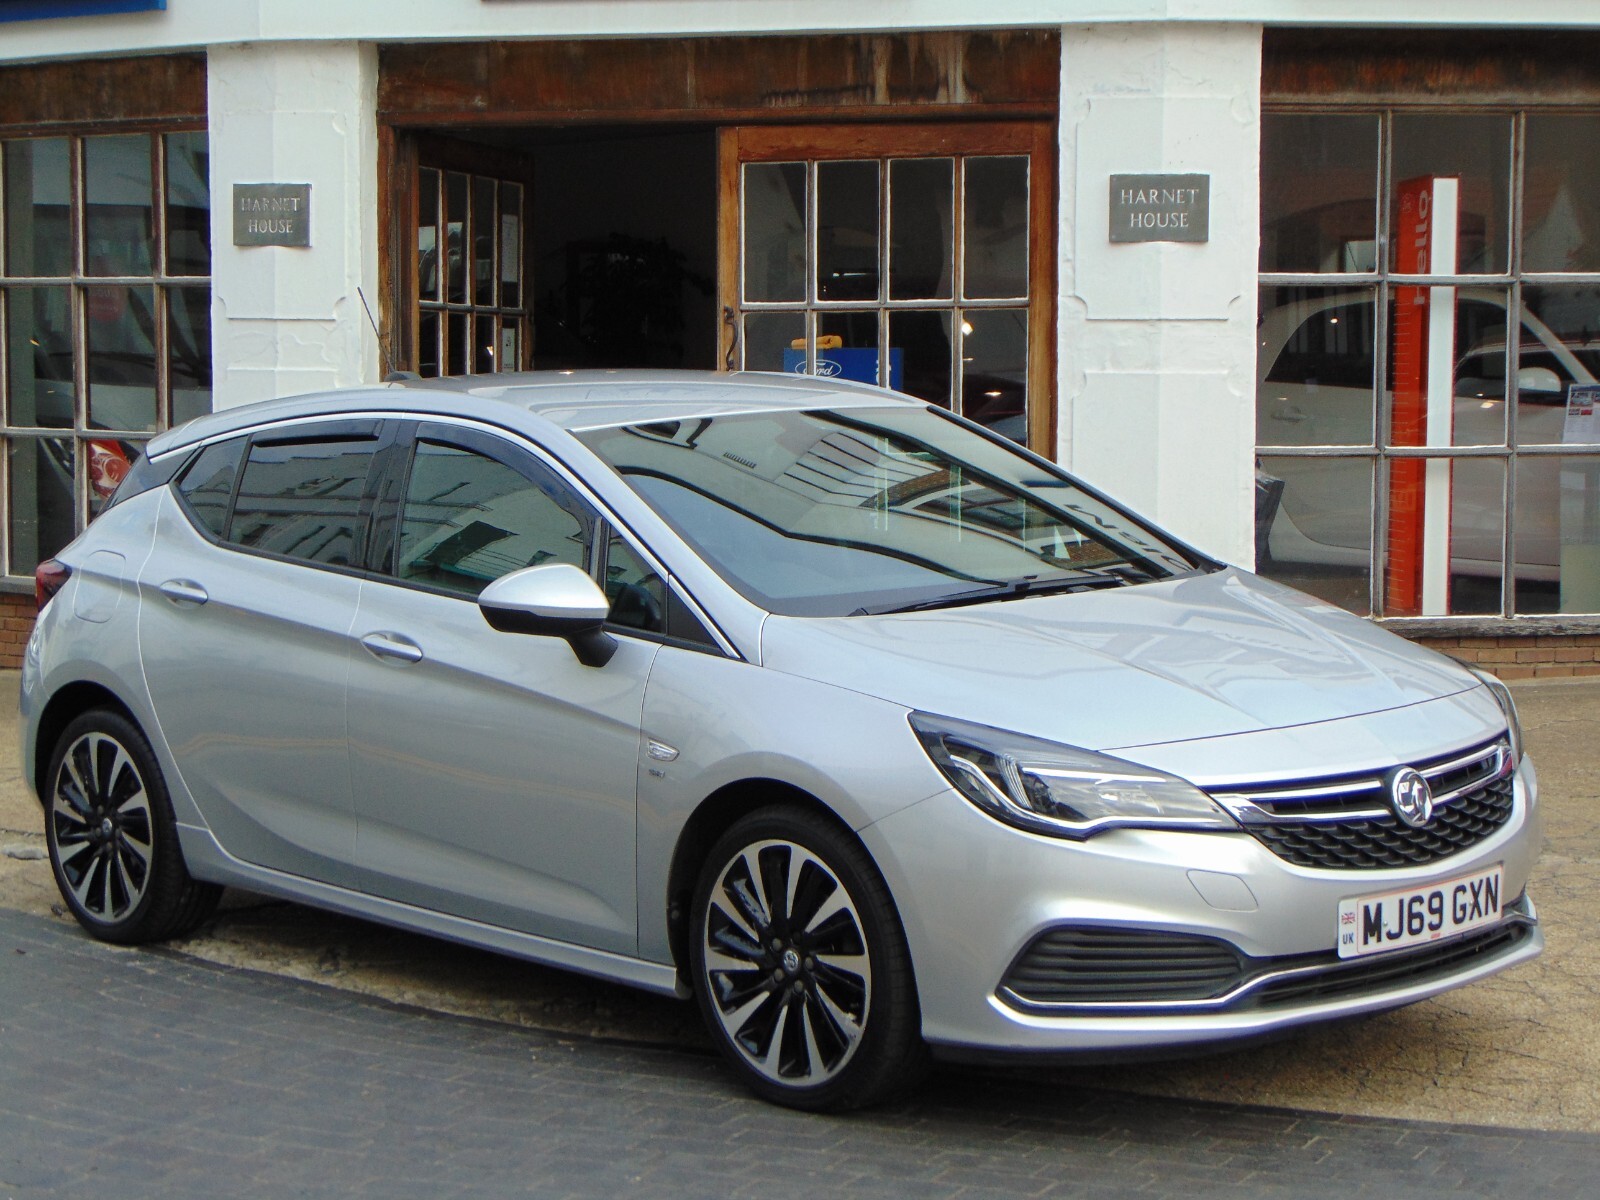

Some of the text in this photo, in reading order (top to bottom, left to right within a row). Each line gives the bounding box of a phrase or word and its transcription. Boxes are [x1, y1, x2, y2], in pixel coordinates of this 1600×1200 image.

[1121, 188, 1199, 204] HARNET
[241, 197, 300, 212] HARNET
[248, 219, 293, 233] HOUSE
[1130, 212, 1189, 228] HOUSE
[802, 362, 833, 376] Frd
[1363, 874, 1499, 945] MJ69 GXN
[1342, 932, 1354, 945] UK
